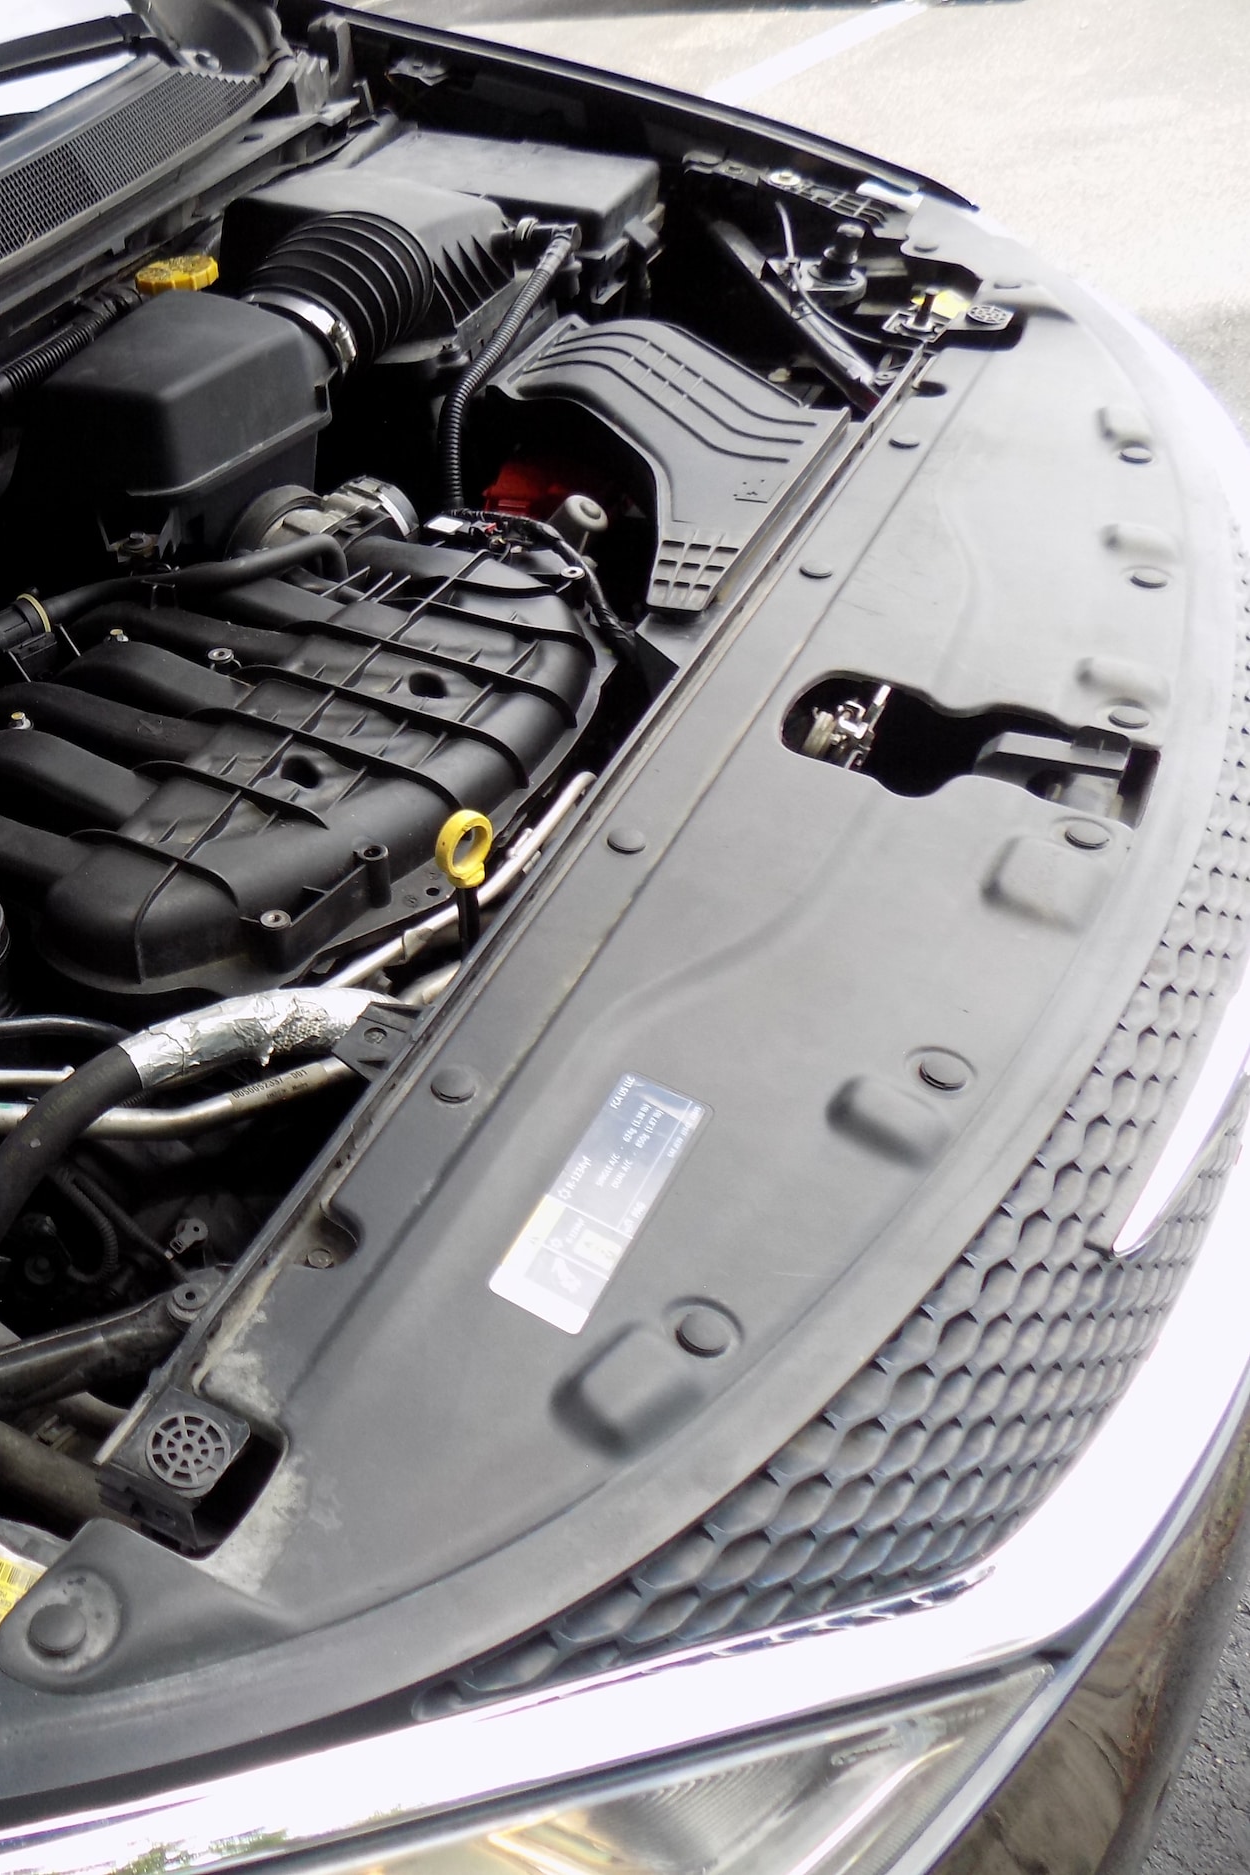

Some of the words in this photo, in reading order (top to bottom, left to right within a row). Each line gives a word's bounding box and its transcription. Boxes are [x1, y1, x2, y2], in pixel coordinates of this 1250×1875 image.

[610, 1095, 624, 1110] FCA
[618, 1087, 630, 1098] US
[624, 1075, 636, 1088] LLC
[609, 1152, 621, 1166] A/C
[623, 1127, 638, 1143] 624g
[611, 1170, 626, 1189] DUAL
[622, 1159, 634, 1172] A/C
